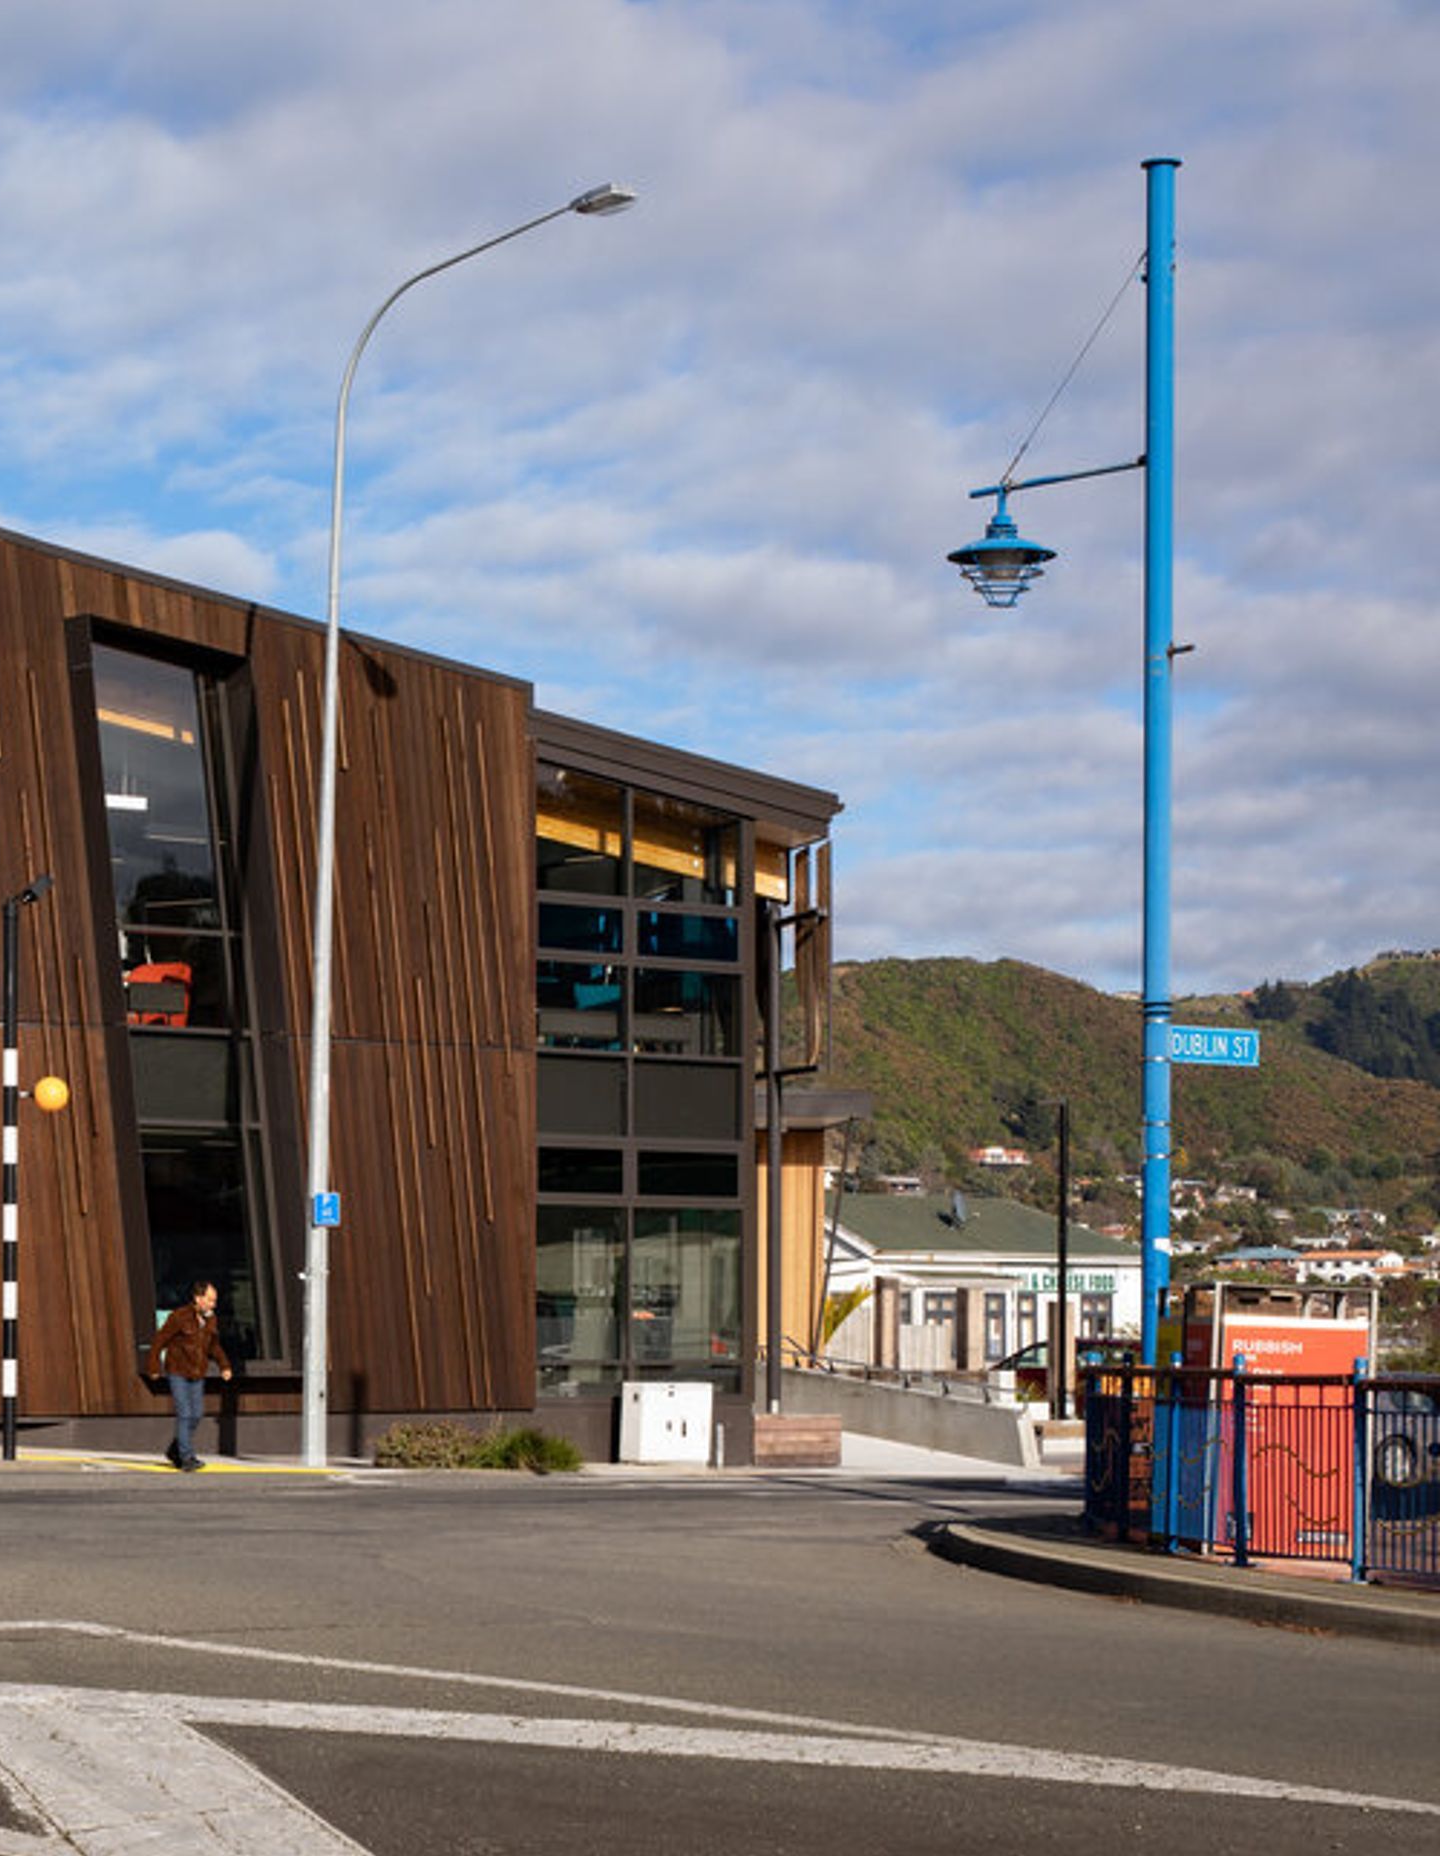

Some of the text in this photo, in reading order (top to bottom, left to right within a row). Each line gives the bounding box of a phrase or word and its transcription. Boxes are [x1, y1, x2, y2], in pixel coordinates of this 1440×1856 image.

[1172, 1032, 1250, 1058] DUBLIN ST
[1043, 1274, 1085, 1291] CHESE
[1232, 1339, 1303, 1355] RUBBISH
